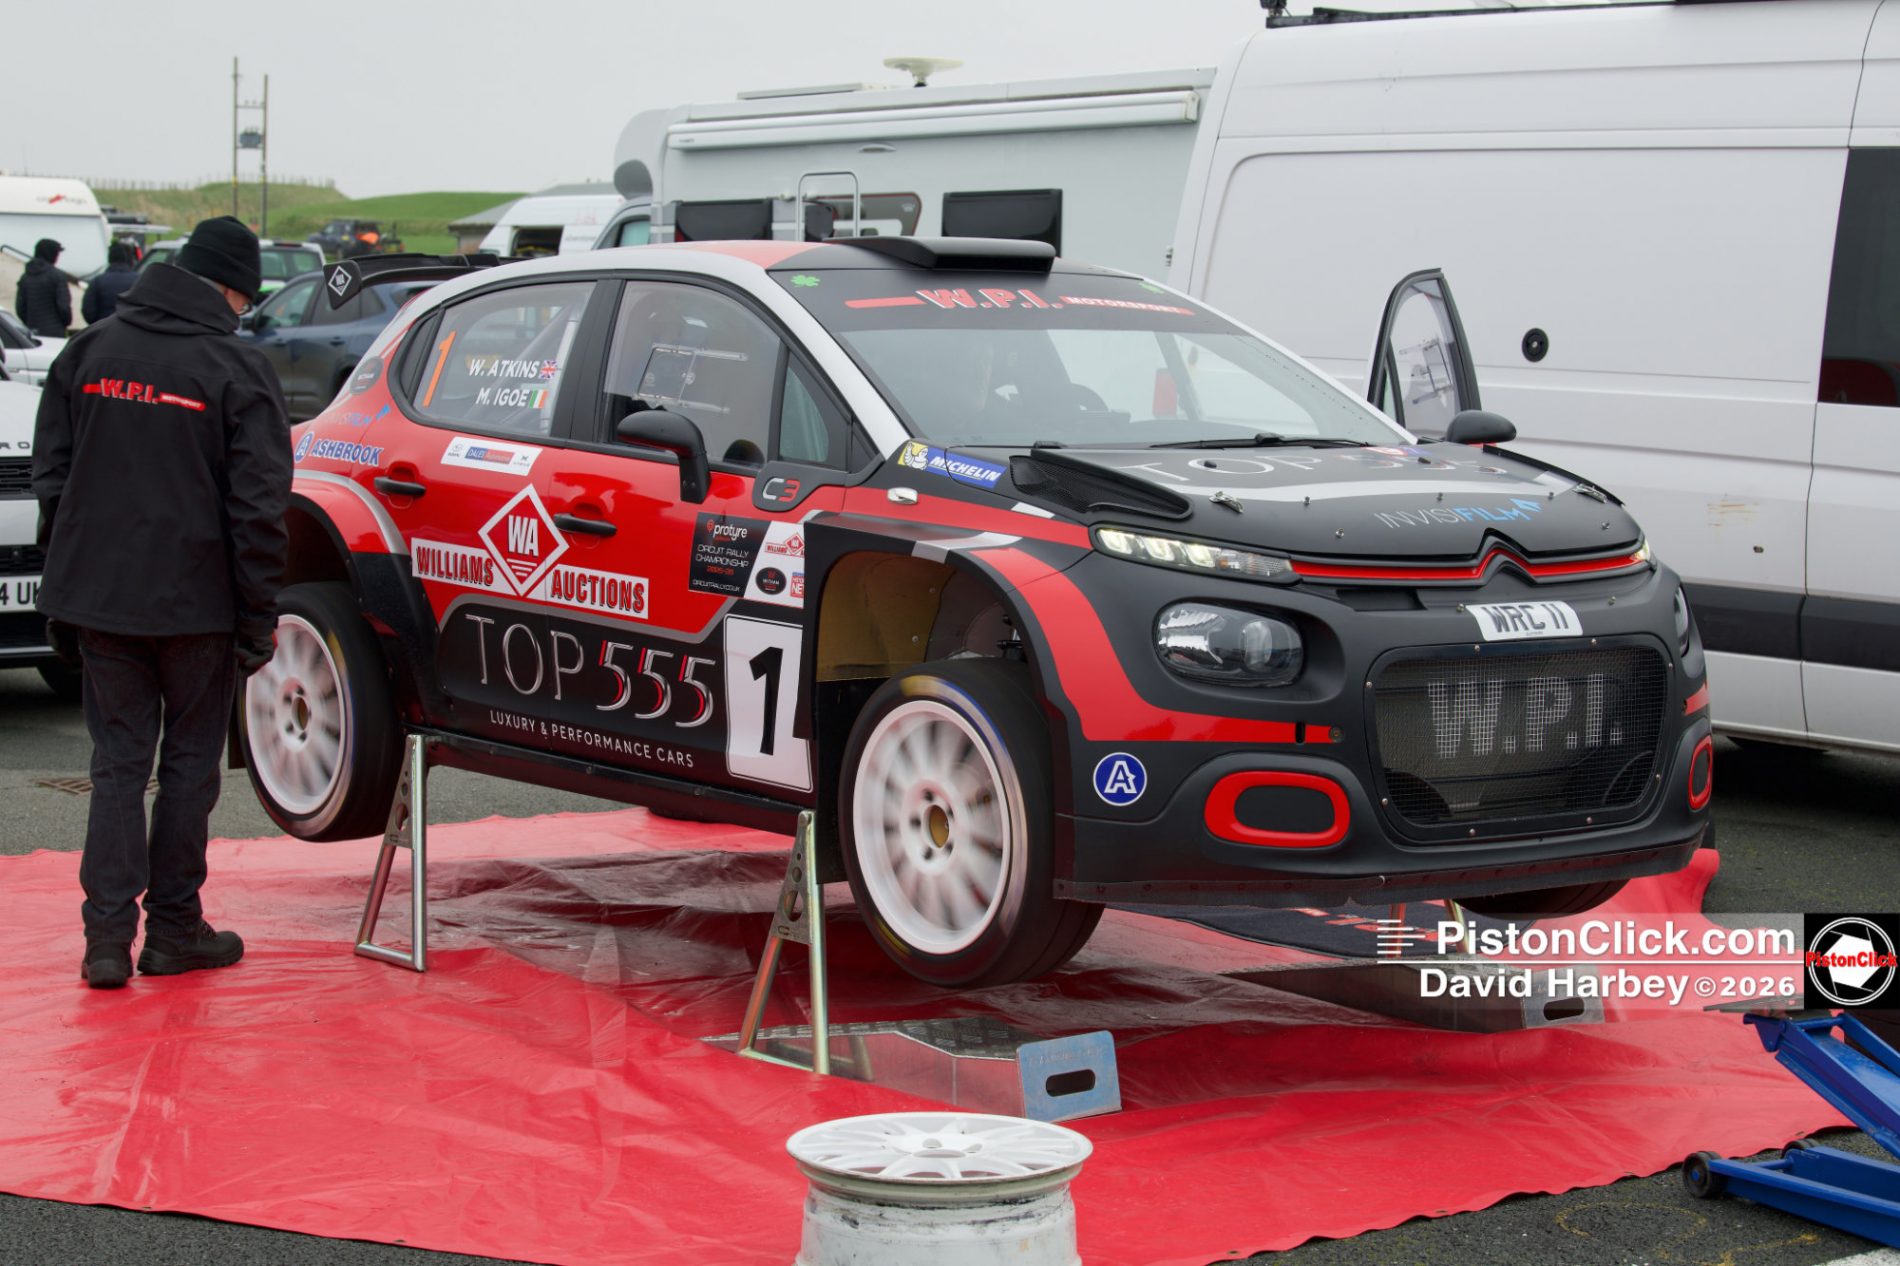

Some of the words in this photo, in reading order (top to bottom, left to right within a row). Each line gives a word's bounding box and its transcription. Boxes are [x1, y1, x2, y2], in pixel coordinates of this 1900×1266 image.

[915, 289, 1064, 309] W.P.I.
[422, 330, 457, 408] 1
[468, 358, 485, 377] W.
[487, 359, 540, 379] ATKINS
[100, 378, 158, 405] W.P.I.
[475, 387, 490, 405] M.
[493, 388, 530, 407] IGOE
[311, 438, 384, 467] ASHBROOK
[929, 456, 1002, 482] MICHELIN
[762, 477, 800, 501] C3
[713, 523, 748, 541] protyre
[1374, 507, 1530, 530] INVISIFILM
[507, 514, 539, 558] WA
[695, 554, 750, 568] CHAMPIONSHIP
[697, 543, 725, 555] CIRCUIT
[726, 547, 750, 559] RALLY
[416, 545, 495, 587] WILLIAMS
[550, 569, 645, 614] AUCTIONS
[1481, 604, 1546, 633] WRC
[465, 613, 585, 701] TOP
[596, 639, 717, 728] 555
[749, 645, 784, 756] 1
[1428, 673, 1623, 759] W.P.I.
[490, 709, 535, 735] LUXURY
[540, 720, 548, 736] &
[551, 725, 651, 760] PERFORMANCE
[656, 747, 694, 768] CARS
